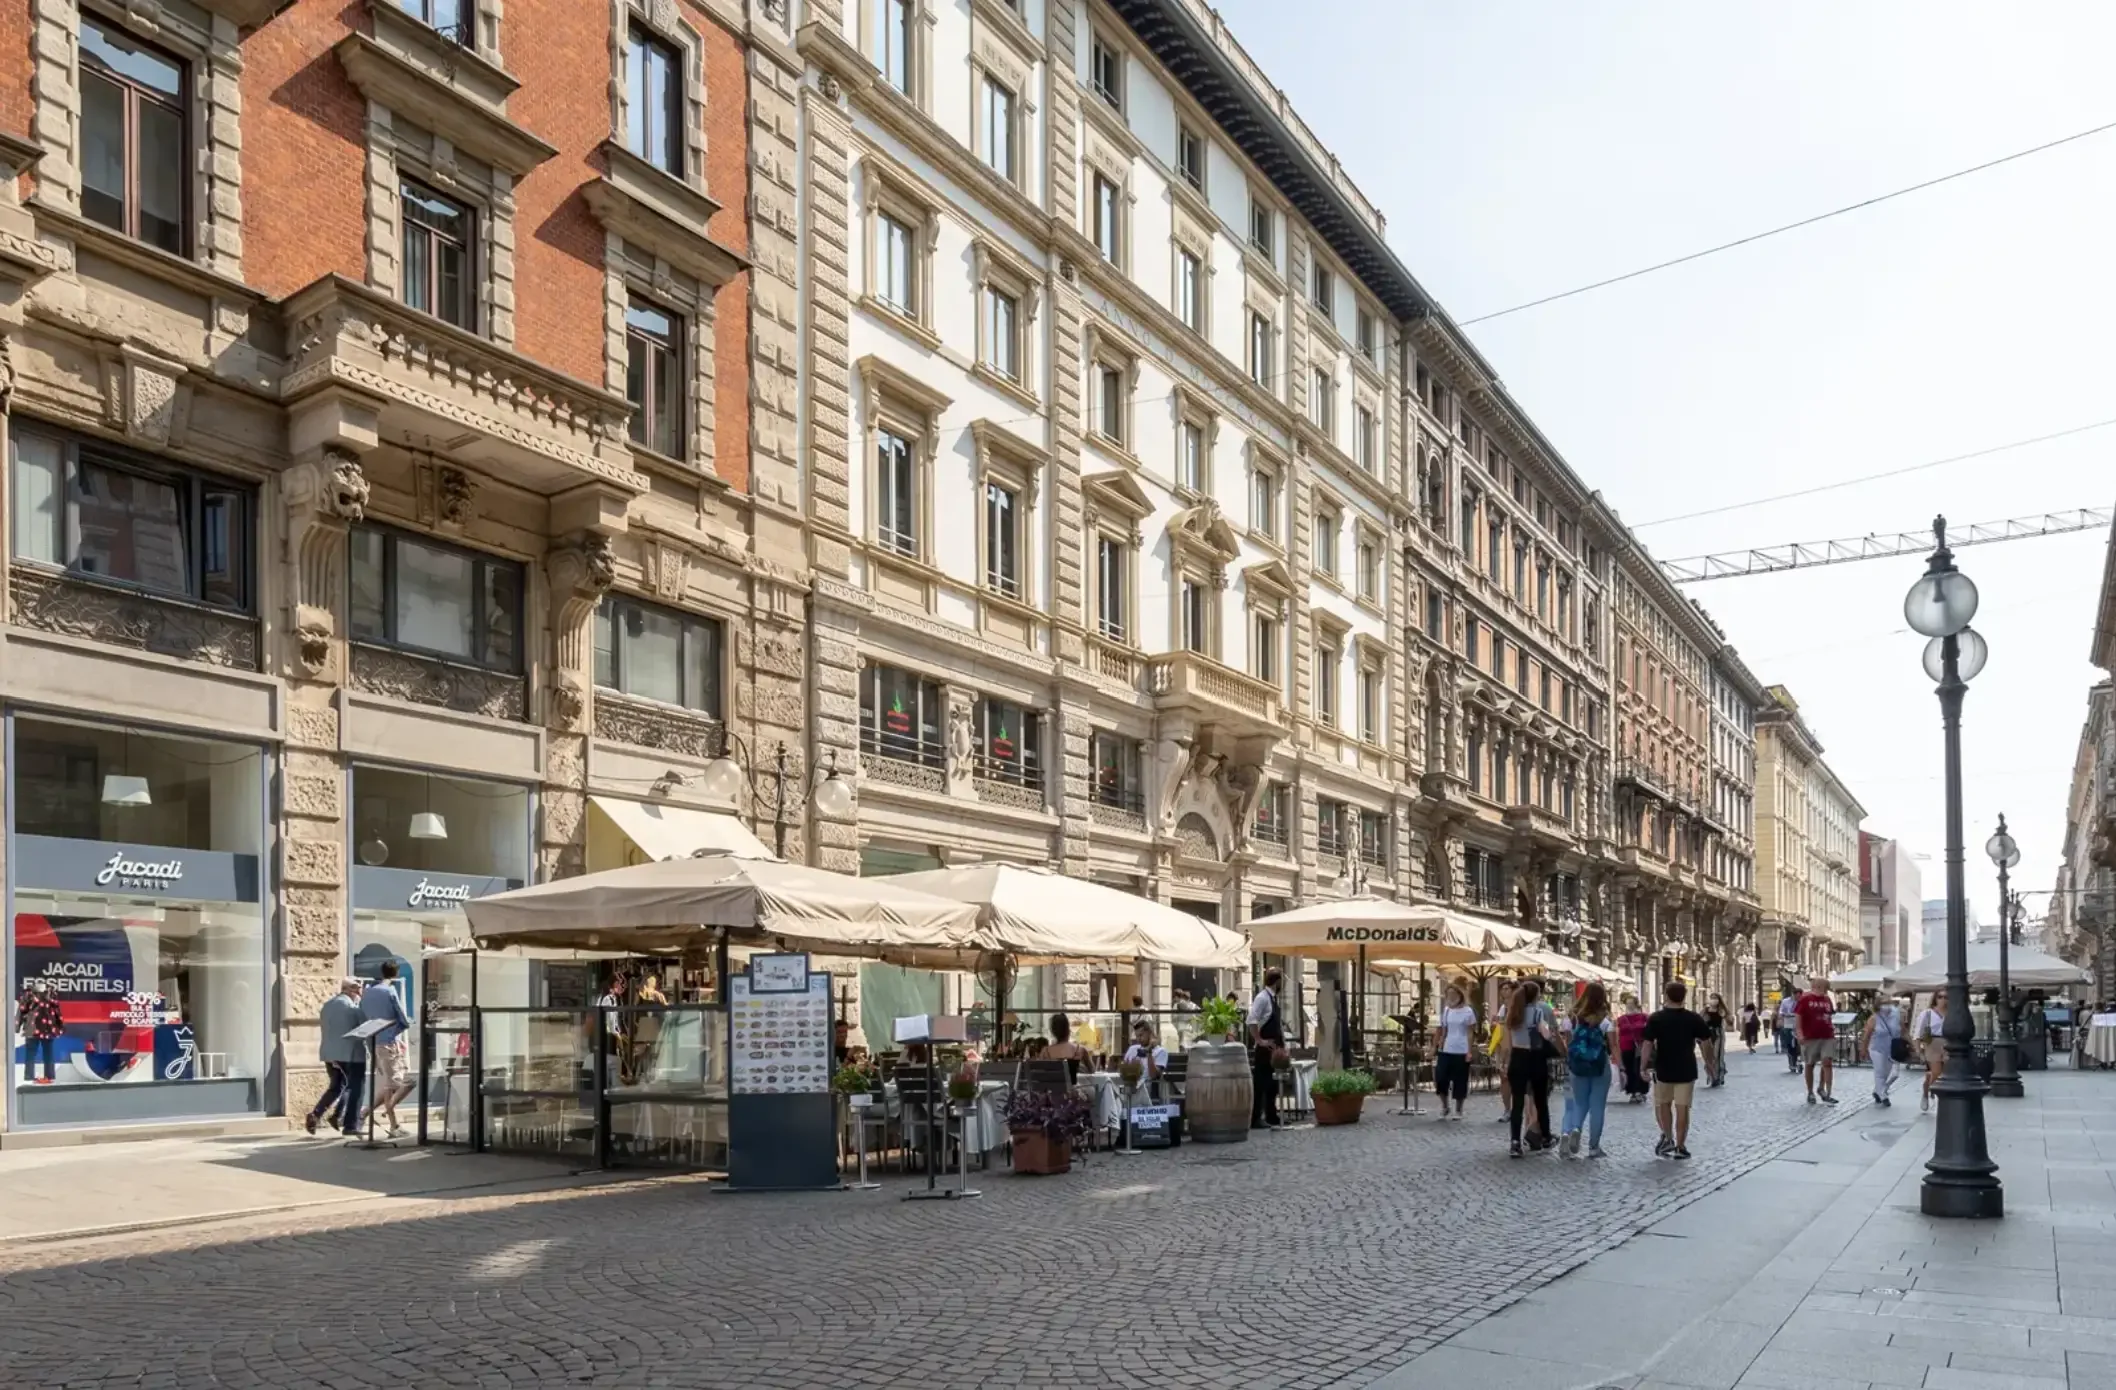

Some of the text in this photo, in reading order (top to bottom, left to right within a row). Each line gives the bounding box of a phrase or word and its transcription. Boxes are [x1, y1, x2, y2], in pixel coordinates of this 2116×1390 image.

[122, 877, 169, 889] PARIS
[1326, 926, 1439, 941] McDonald's
[42, 962, 104, 977] JACADI
